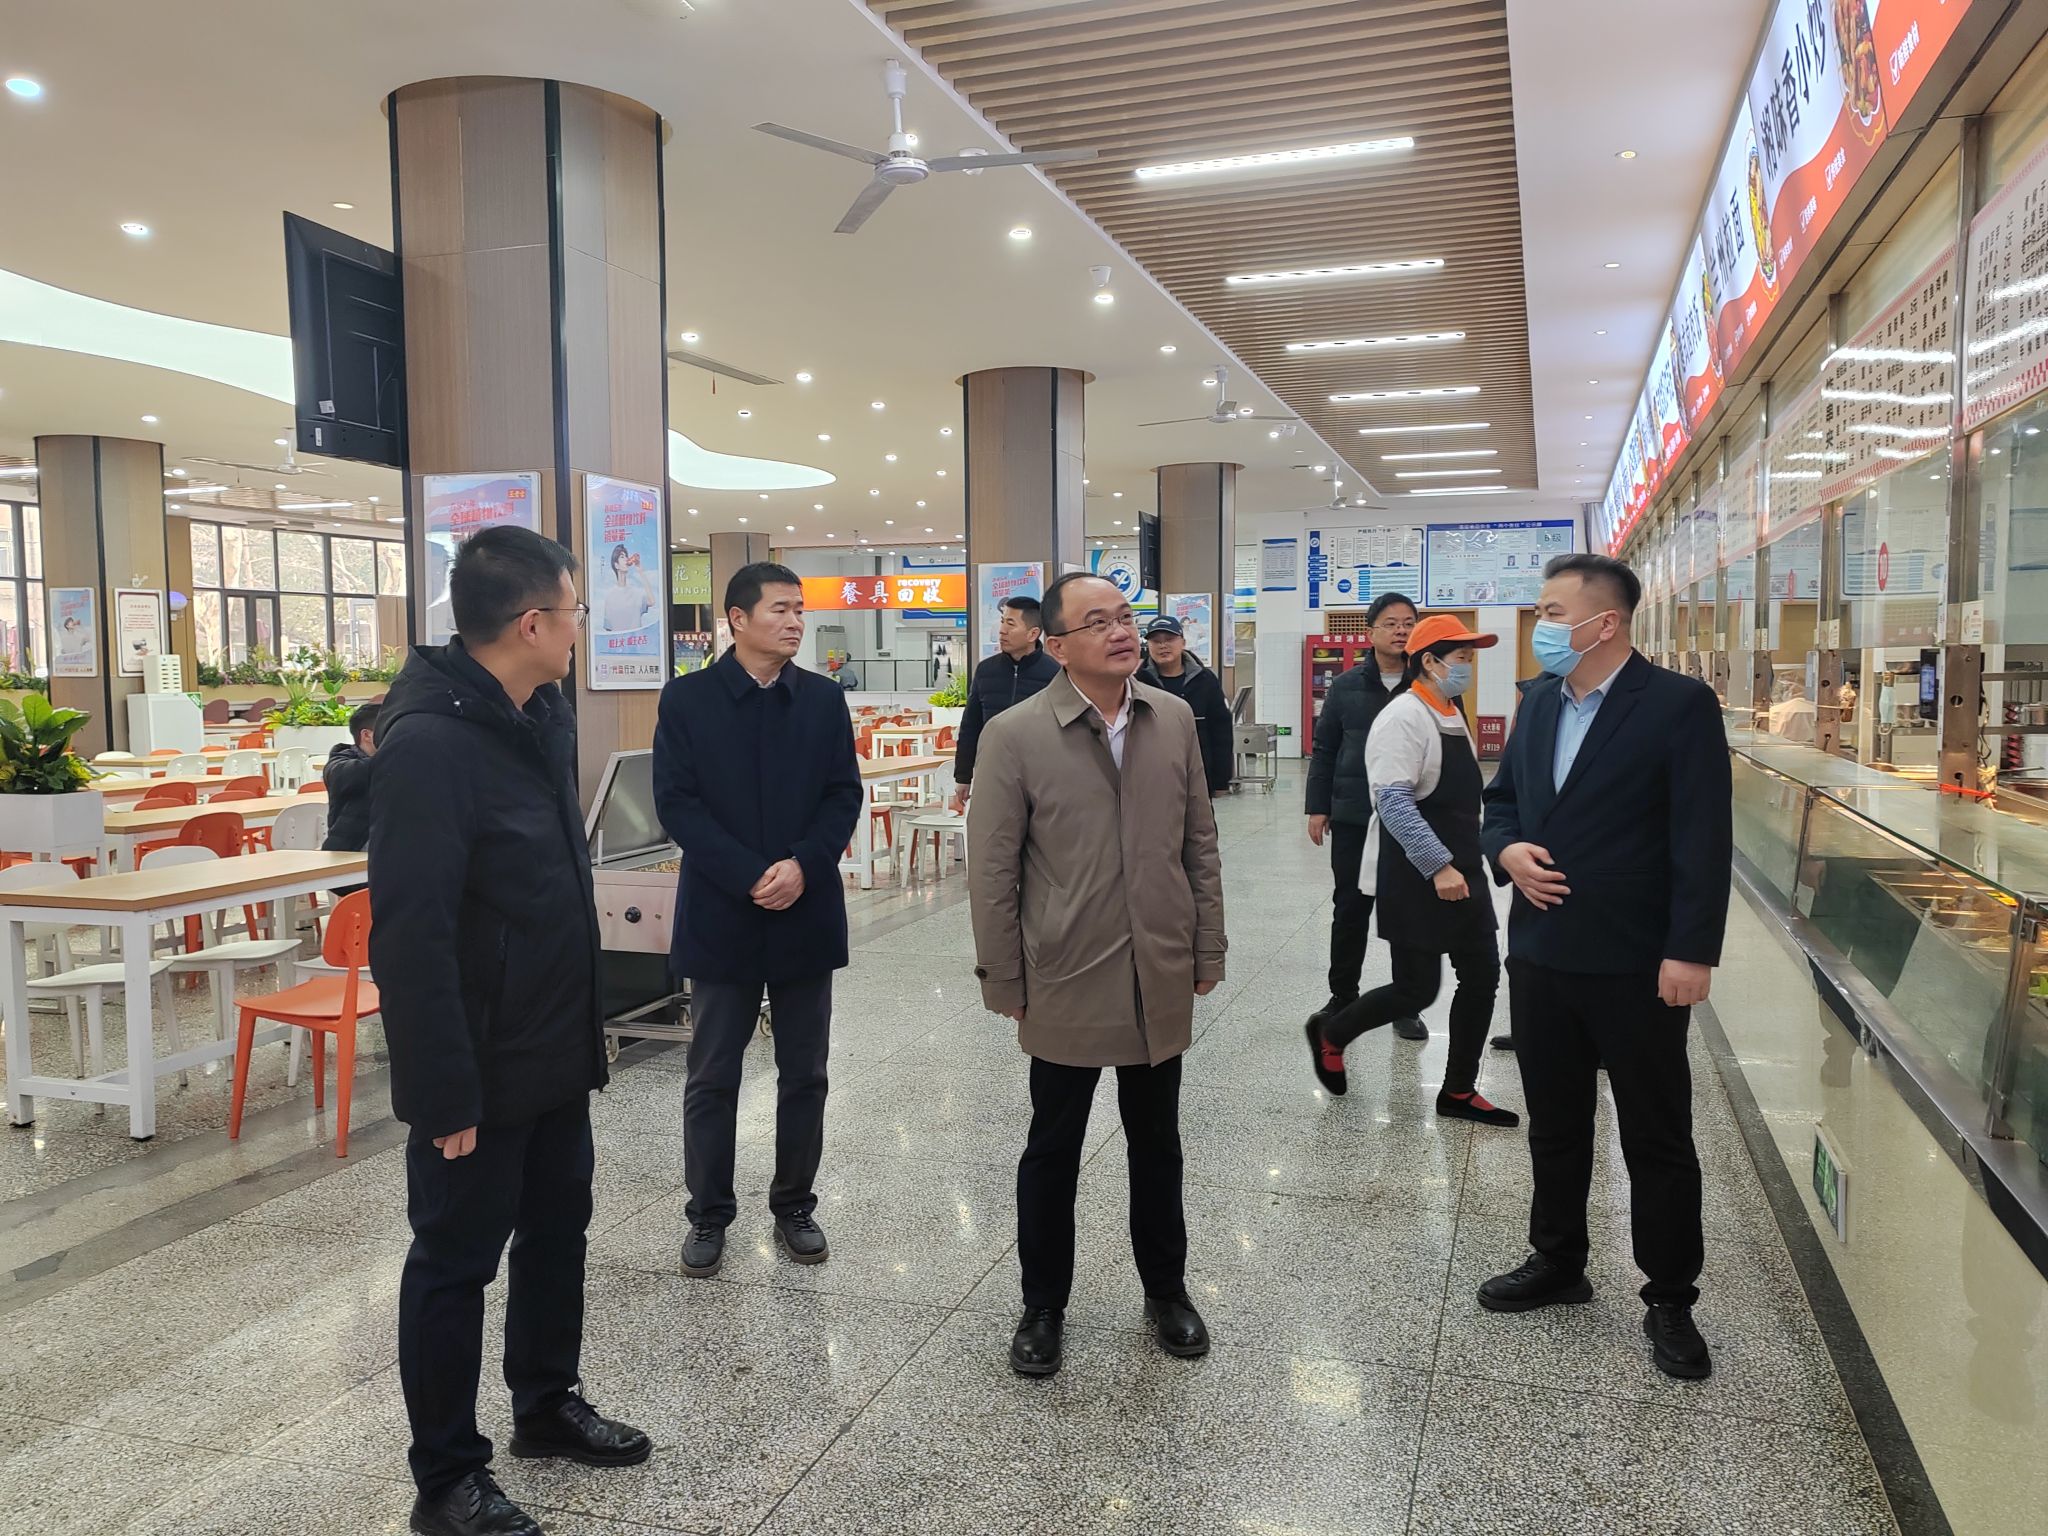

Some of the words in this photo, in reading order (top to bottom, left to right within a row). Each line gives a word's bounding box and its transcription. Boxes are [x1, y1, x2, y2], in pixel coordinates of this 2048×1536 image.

[1708, 186, 1745, 304] 兰州拉面
[840, 580, 944, 605] 餐具回收
[897, 578, 942, 588] recovery
